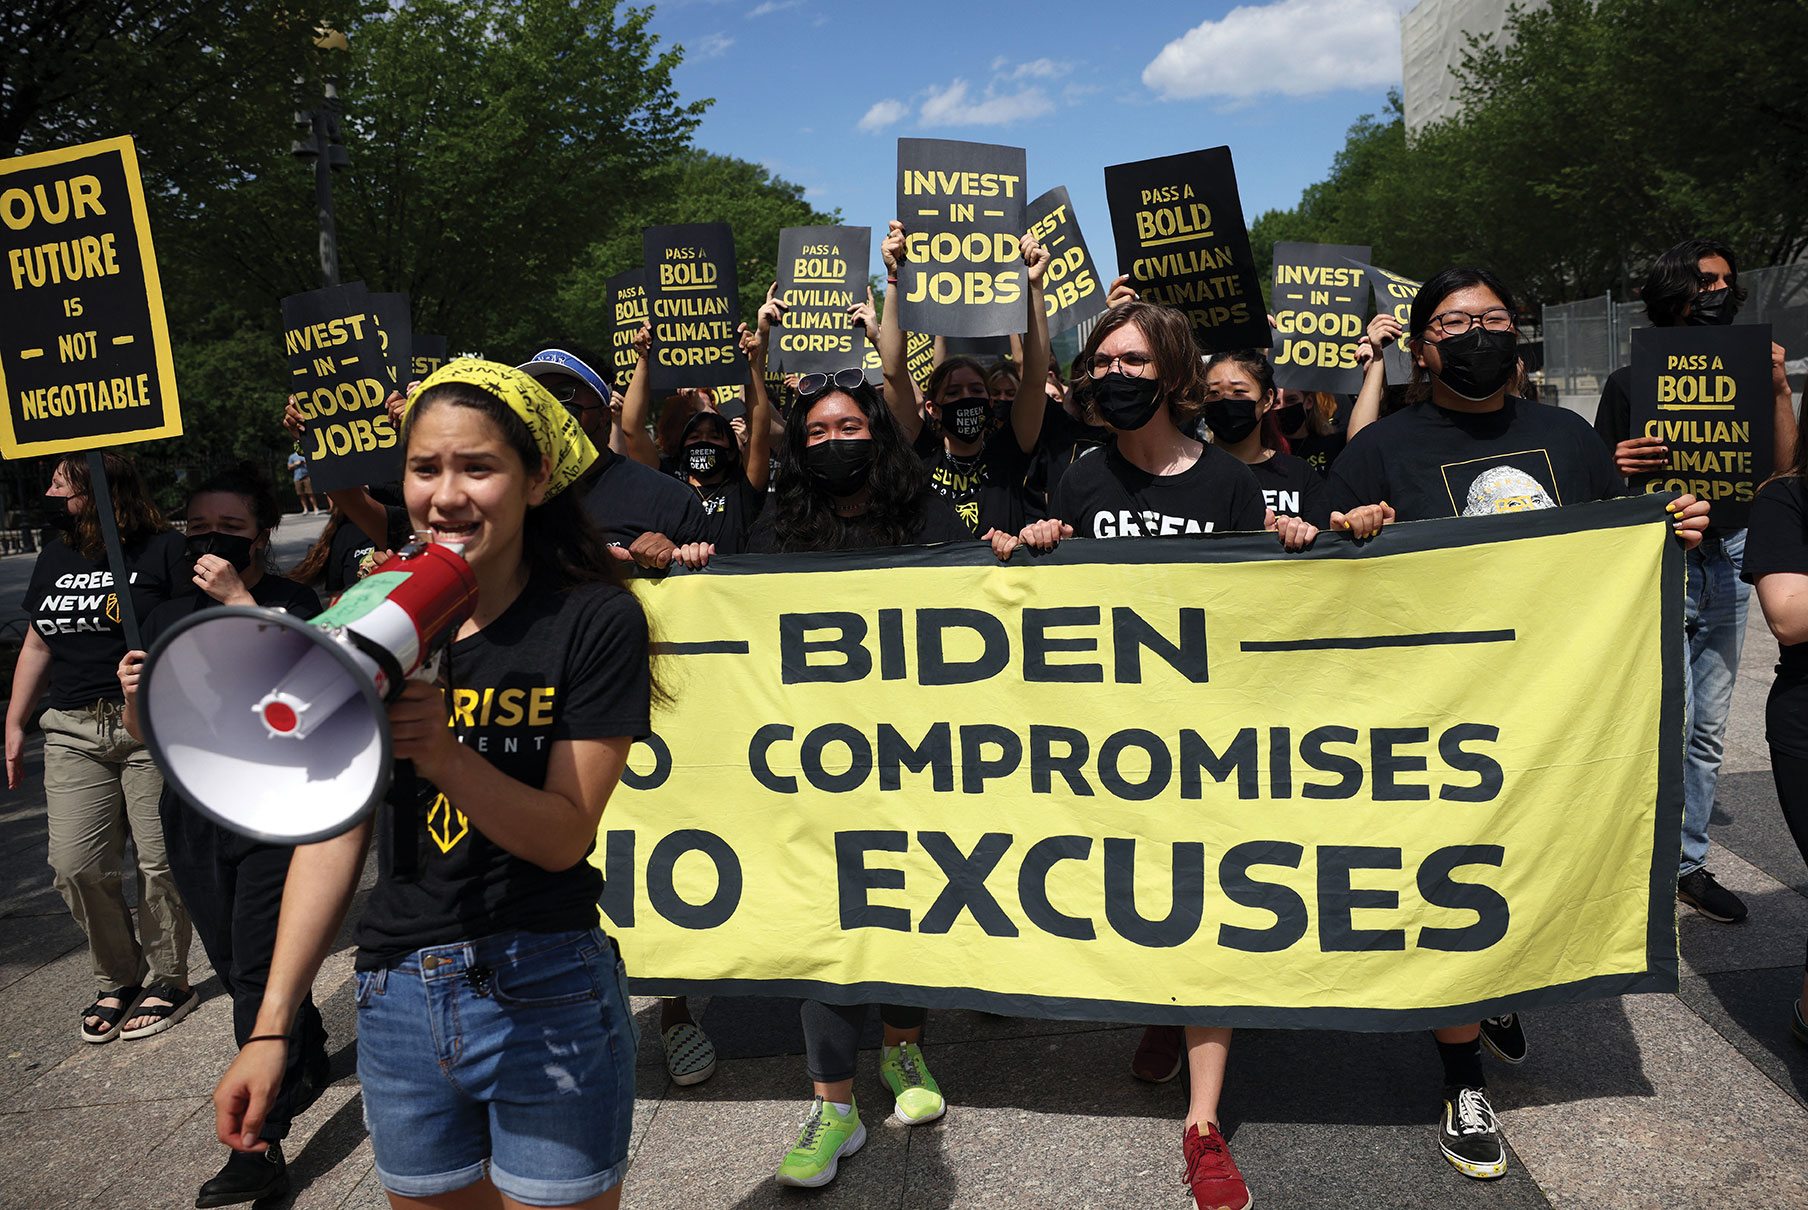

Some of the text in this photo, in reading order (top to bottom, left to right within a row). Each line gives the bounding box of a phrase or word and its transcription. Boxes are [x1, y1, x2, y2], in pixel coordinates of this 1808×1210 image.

[904, 169, 1020, 198] INVEST
[1141, 183, 1195, 206] PASS A
[0, 174, 106, 230] OUR
[950, 203, 975, 223] IN
[1027, 204, 1067, 241] EST
[1136, 203, 1212, 240] BOLD
[665, 247, 707, 260] PASS A
[802, 244, 840, 256] PASS A
[904, 232, 1022, 264] GOOD
[8, 232, 120, 290] FUTURE
[793, 258, 847, 278] BOLD
[1133, 245, 1234, 282] CIVILIAN
[659, 262, 718, 285] BOLD
[1276, 264, 1365, 288] INVEST
[617, 285, 645, 300] PASS A
[783, 289, 853, 307] CIVILIAN
[906, 271, 1021, 305] JOBS
[1043, 269, 1096, 318] OBS
[1310, 290, 1329, 306] IN
[63, 297, 83, 317] IS
[653, 296, 729, 318] CIVILIAN
[1188, 302, 1251, 330] RPS
[656, 321, 733, 342] CLIMATE
[781, 311, 853, 330] CLIMATE
[1276, 310, 1362, 338] GOOD
[285, 313, 366, 356] NVEST
[780, 334, 852, 353] CORPS
[58, 330, 97, 363] NOT
[658, 345, 735, 367] CORPS
[1274, 339, 1358, 369] JOBS
[313, 356, 337, 377] IN
[1667, 355, 1724, 370] PASS A
[20, 373, 150, 421] NEGOTIABLE
[293, 377, 385, 421] GOOD
[1657, 375, 1737, 403] BOLD
[956, 405, 984, 418] GREEN
[956, 416, 978, 426] NEW
[311, 414, 398, 461] JOBS
[957, 425, 980, 435] DEAL
[1644, 420, 1750, 443] CIVILIAN
[690, 448, 715, 456] GREEN
[690, 455, 707, 463] NEW
[1662, 450, 1753, 474] LIMATE
[690, 462, 710, 470] DEAL
[1645, 478, 1754, 502] CORPS
[39, 594, 105, 612] NEW
[36, 617, 111, 636] DEAL
[779, 606, 1209, 685] BIDEN
[447, 687, 556, 727] RISE
[749, 722, 1504, 803] COMPROMISES
[835, 830, 1511, 953] EXCUSES
